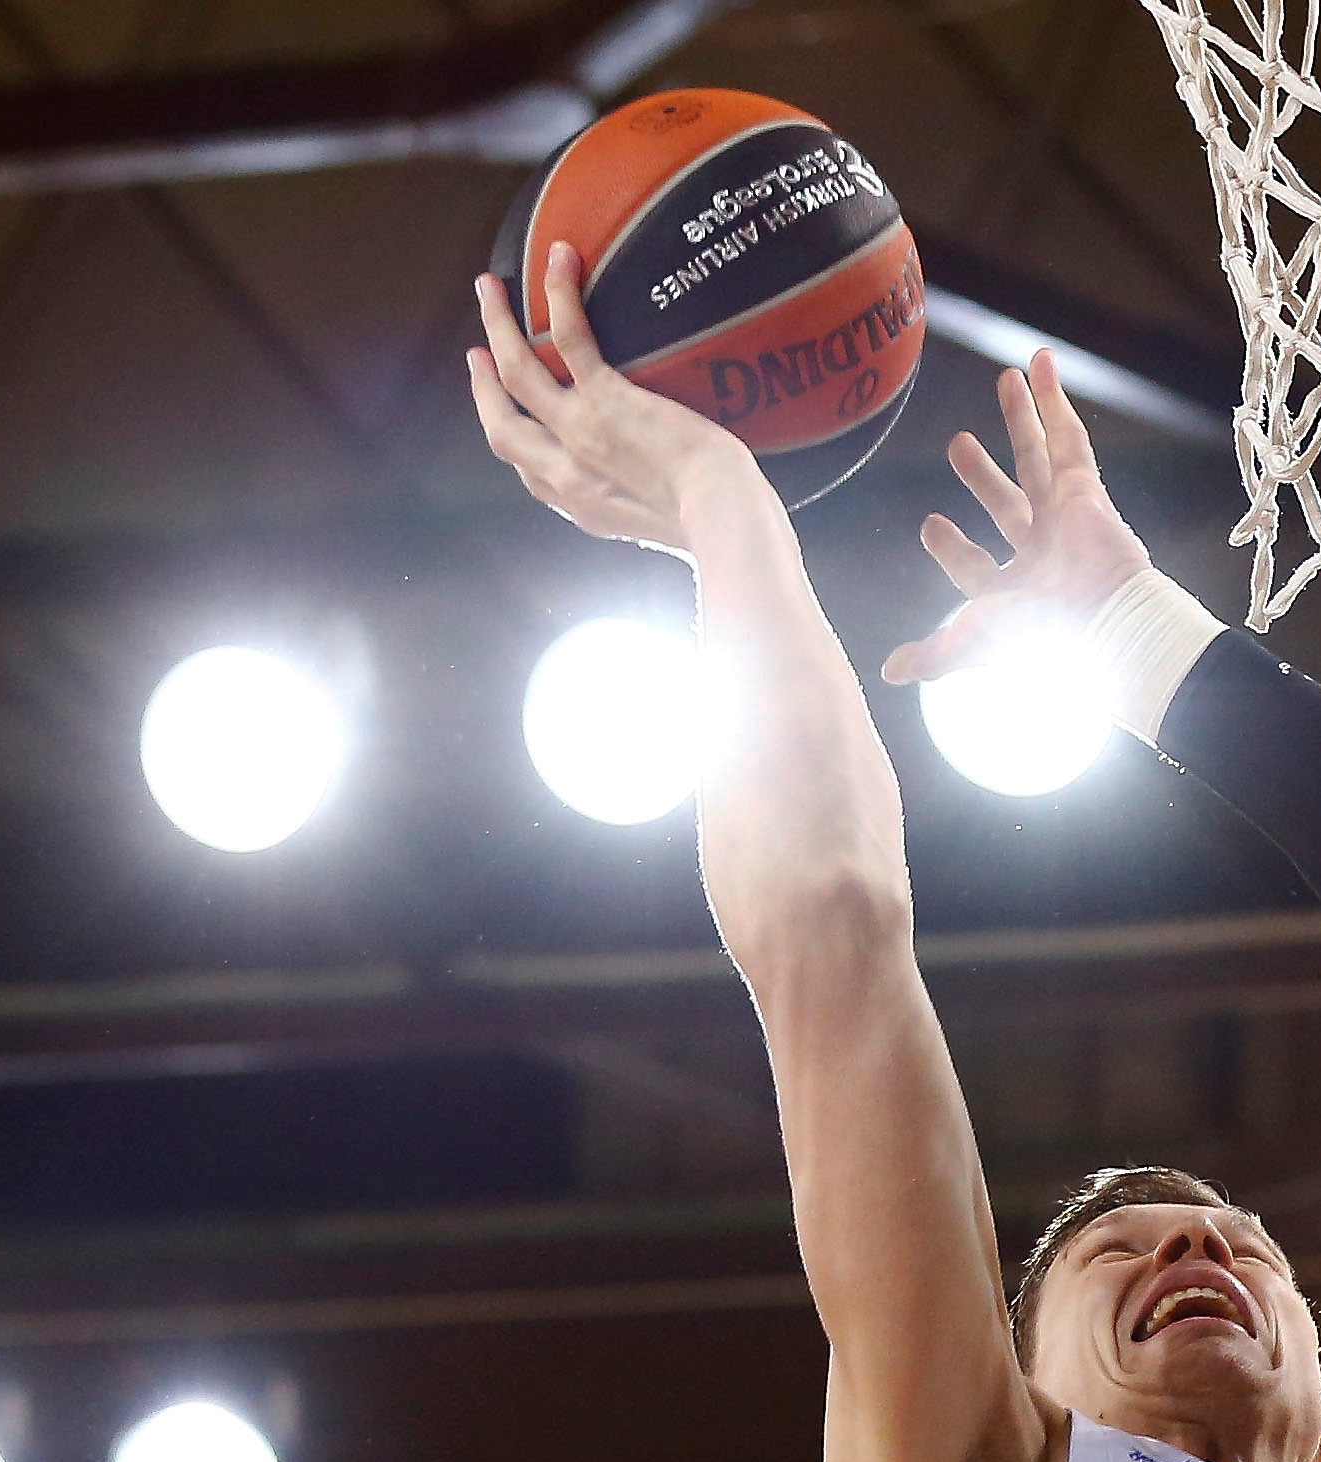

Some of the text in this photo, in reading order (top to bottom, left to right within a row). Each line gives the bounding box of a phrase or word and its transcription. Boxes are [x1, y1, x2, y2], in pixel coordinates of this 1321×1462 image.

[650, 172, 856, 309] TURKISH AIRLINES
[708, 263, 926, 423] PALDING
